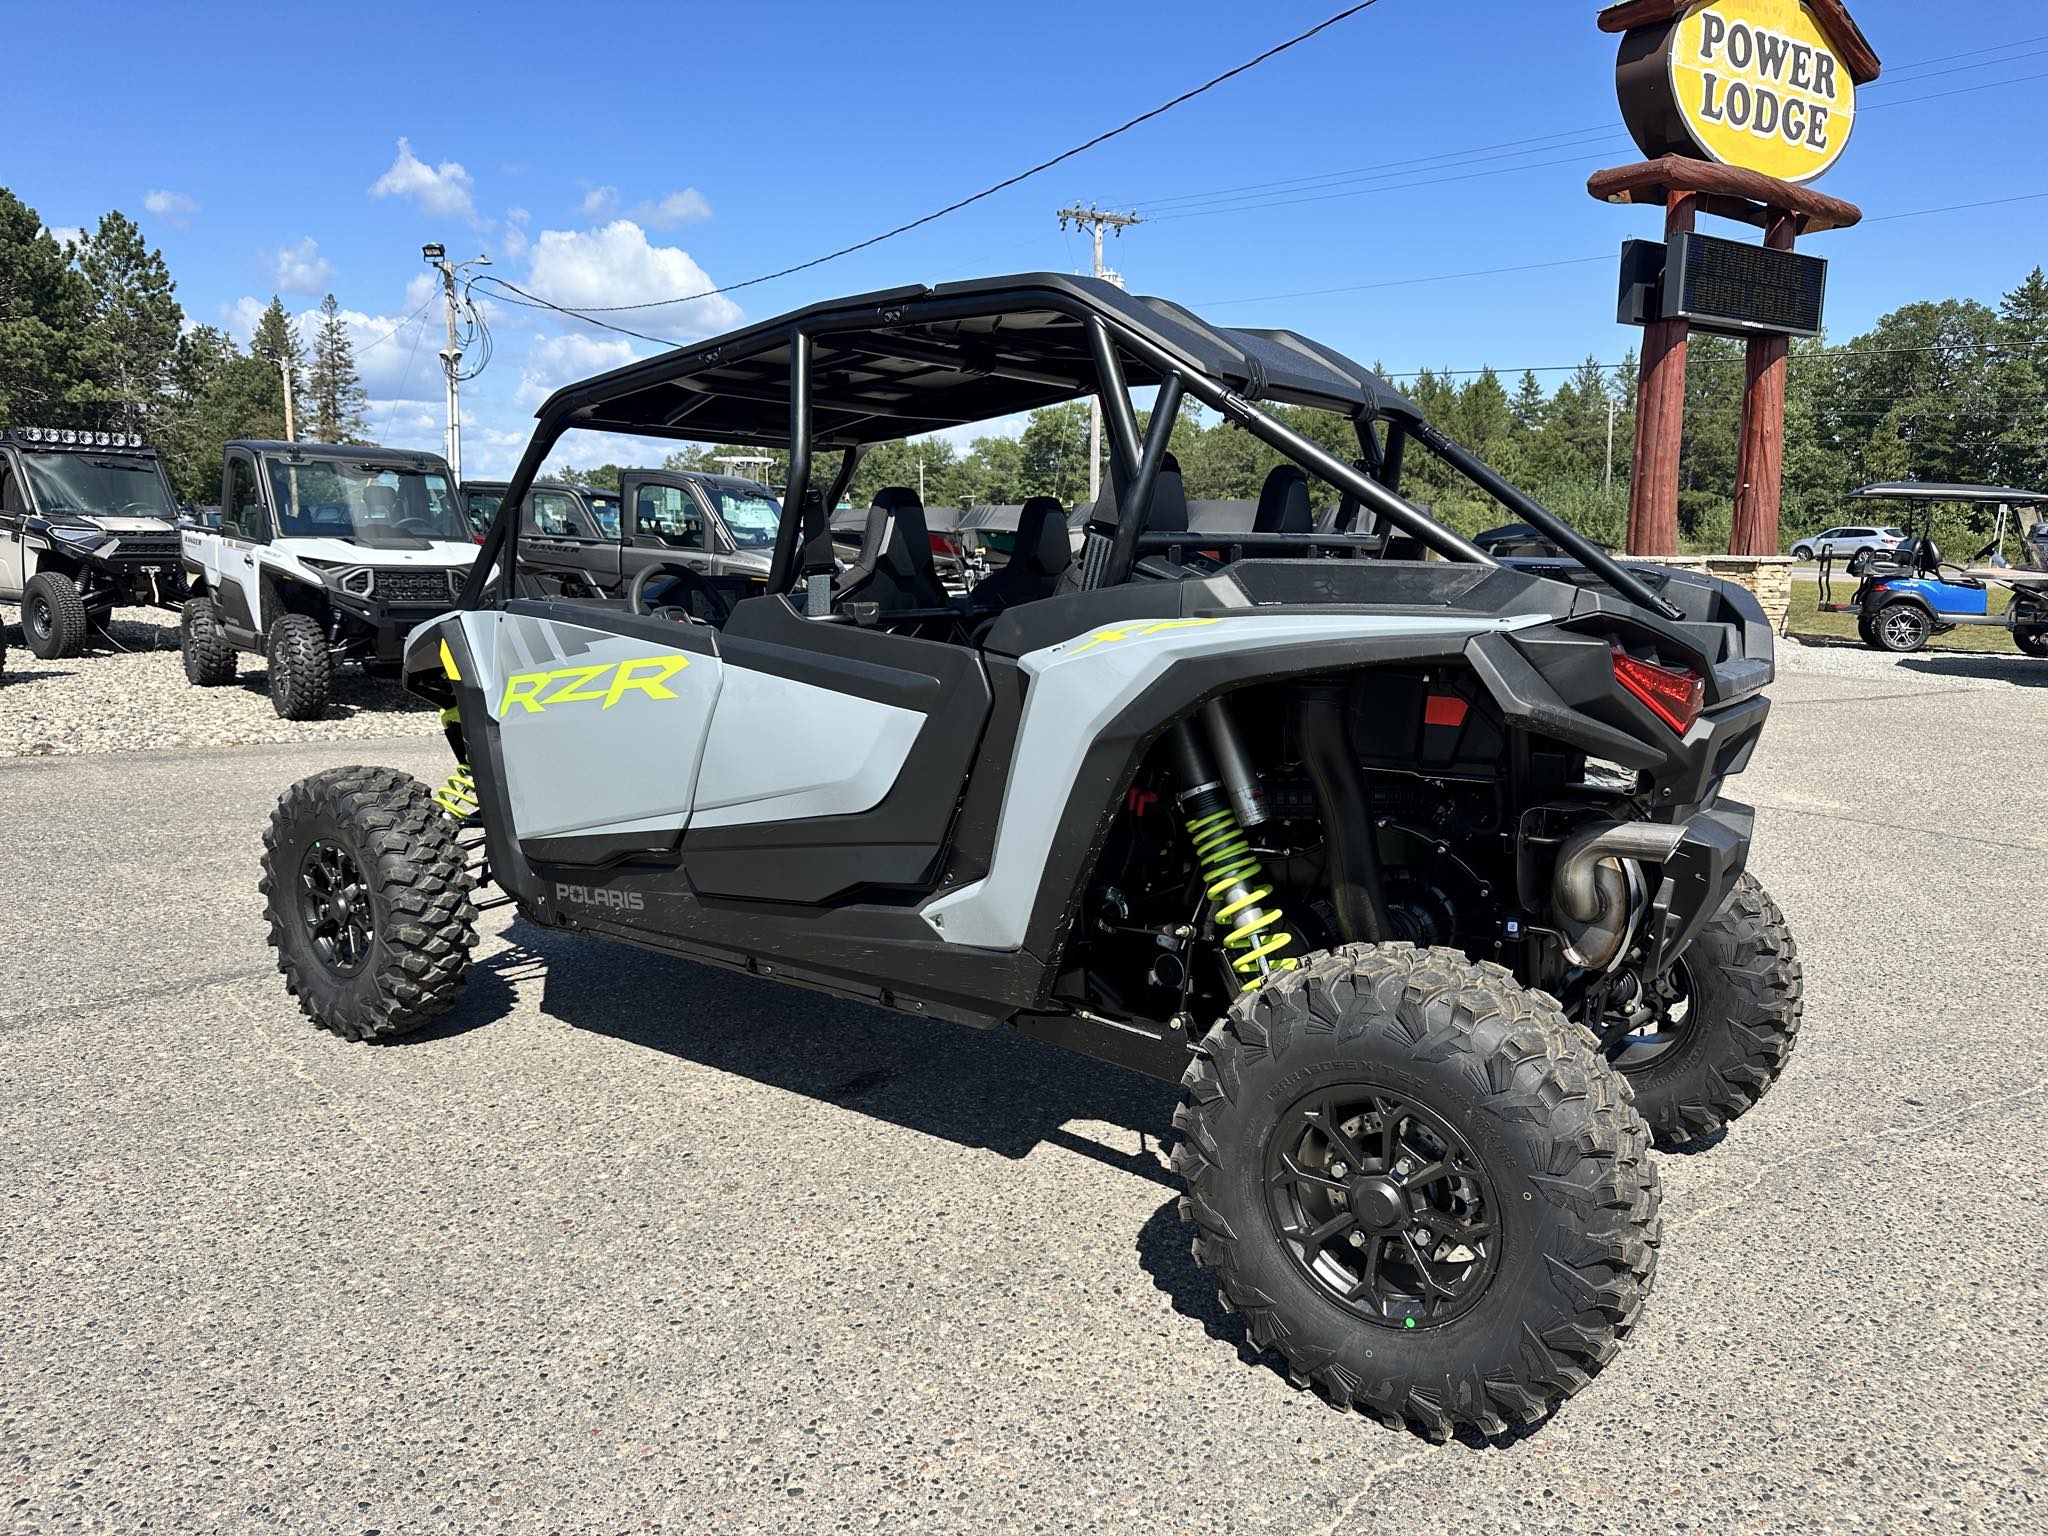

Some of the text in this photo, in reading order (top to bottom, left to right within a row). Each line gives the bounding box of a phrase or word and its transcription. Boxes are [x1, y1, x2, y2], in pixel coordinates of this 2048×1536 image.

[1700, 12, 1836, 98] POWER
[1701, 73, 1828, 149] LODGE
[1701, 239, 1803, 289] FINANCING
[528, 543, 580, 553] RANGER
[377, 577, 444, 588] POLARIS
[500, 655, 691, 717] RZR
[555, 882, 645, 911] POLARIS
